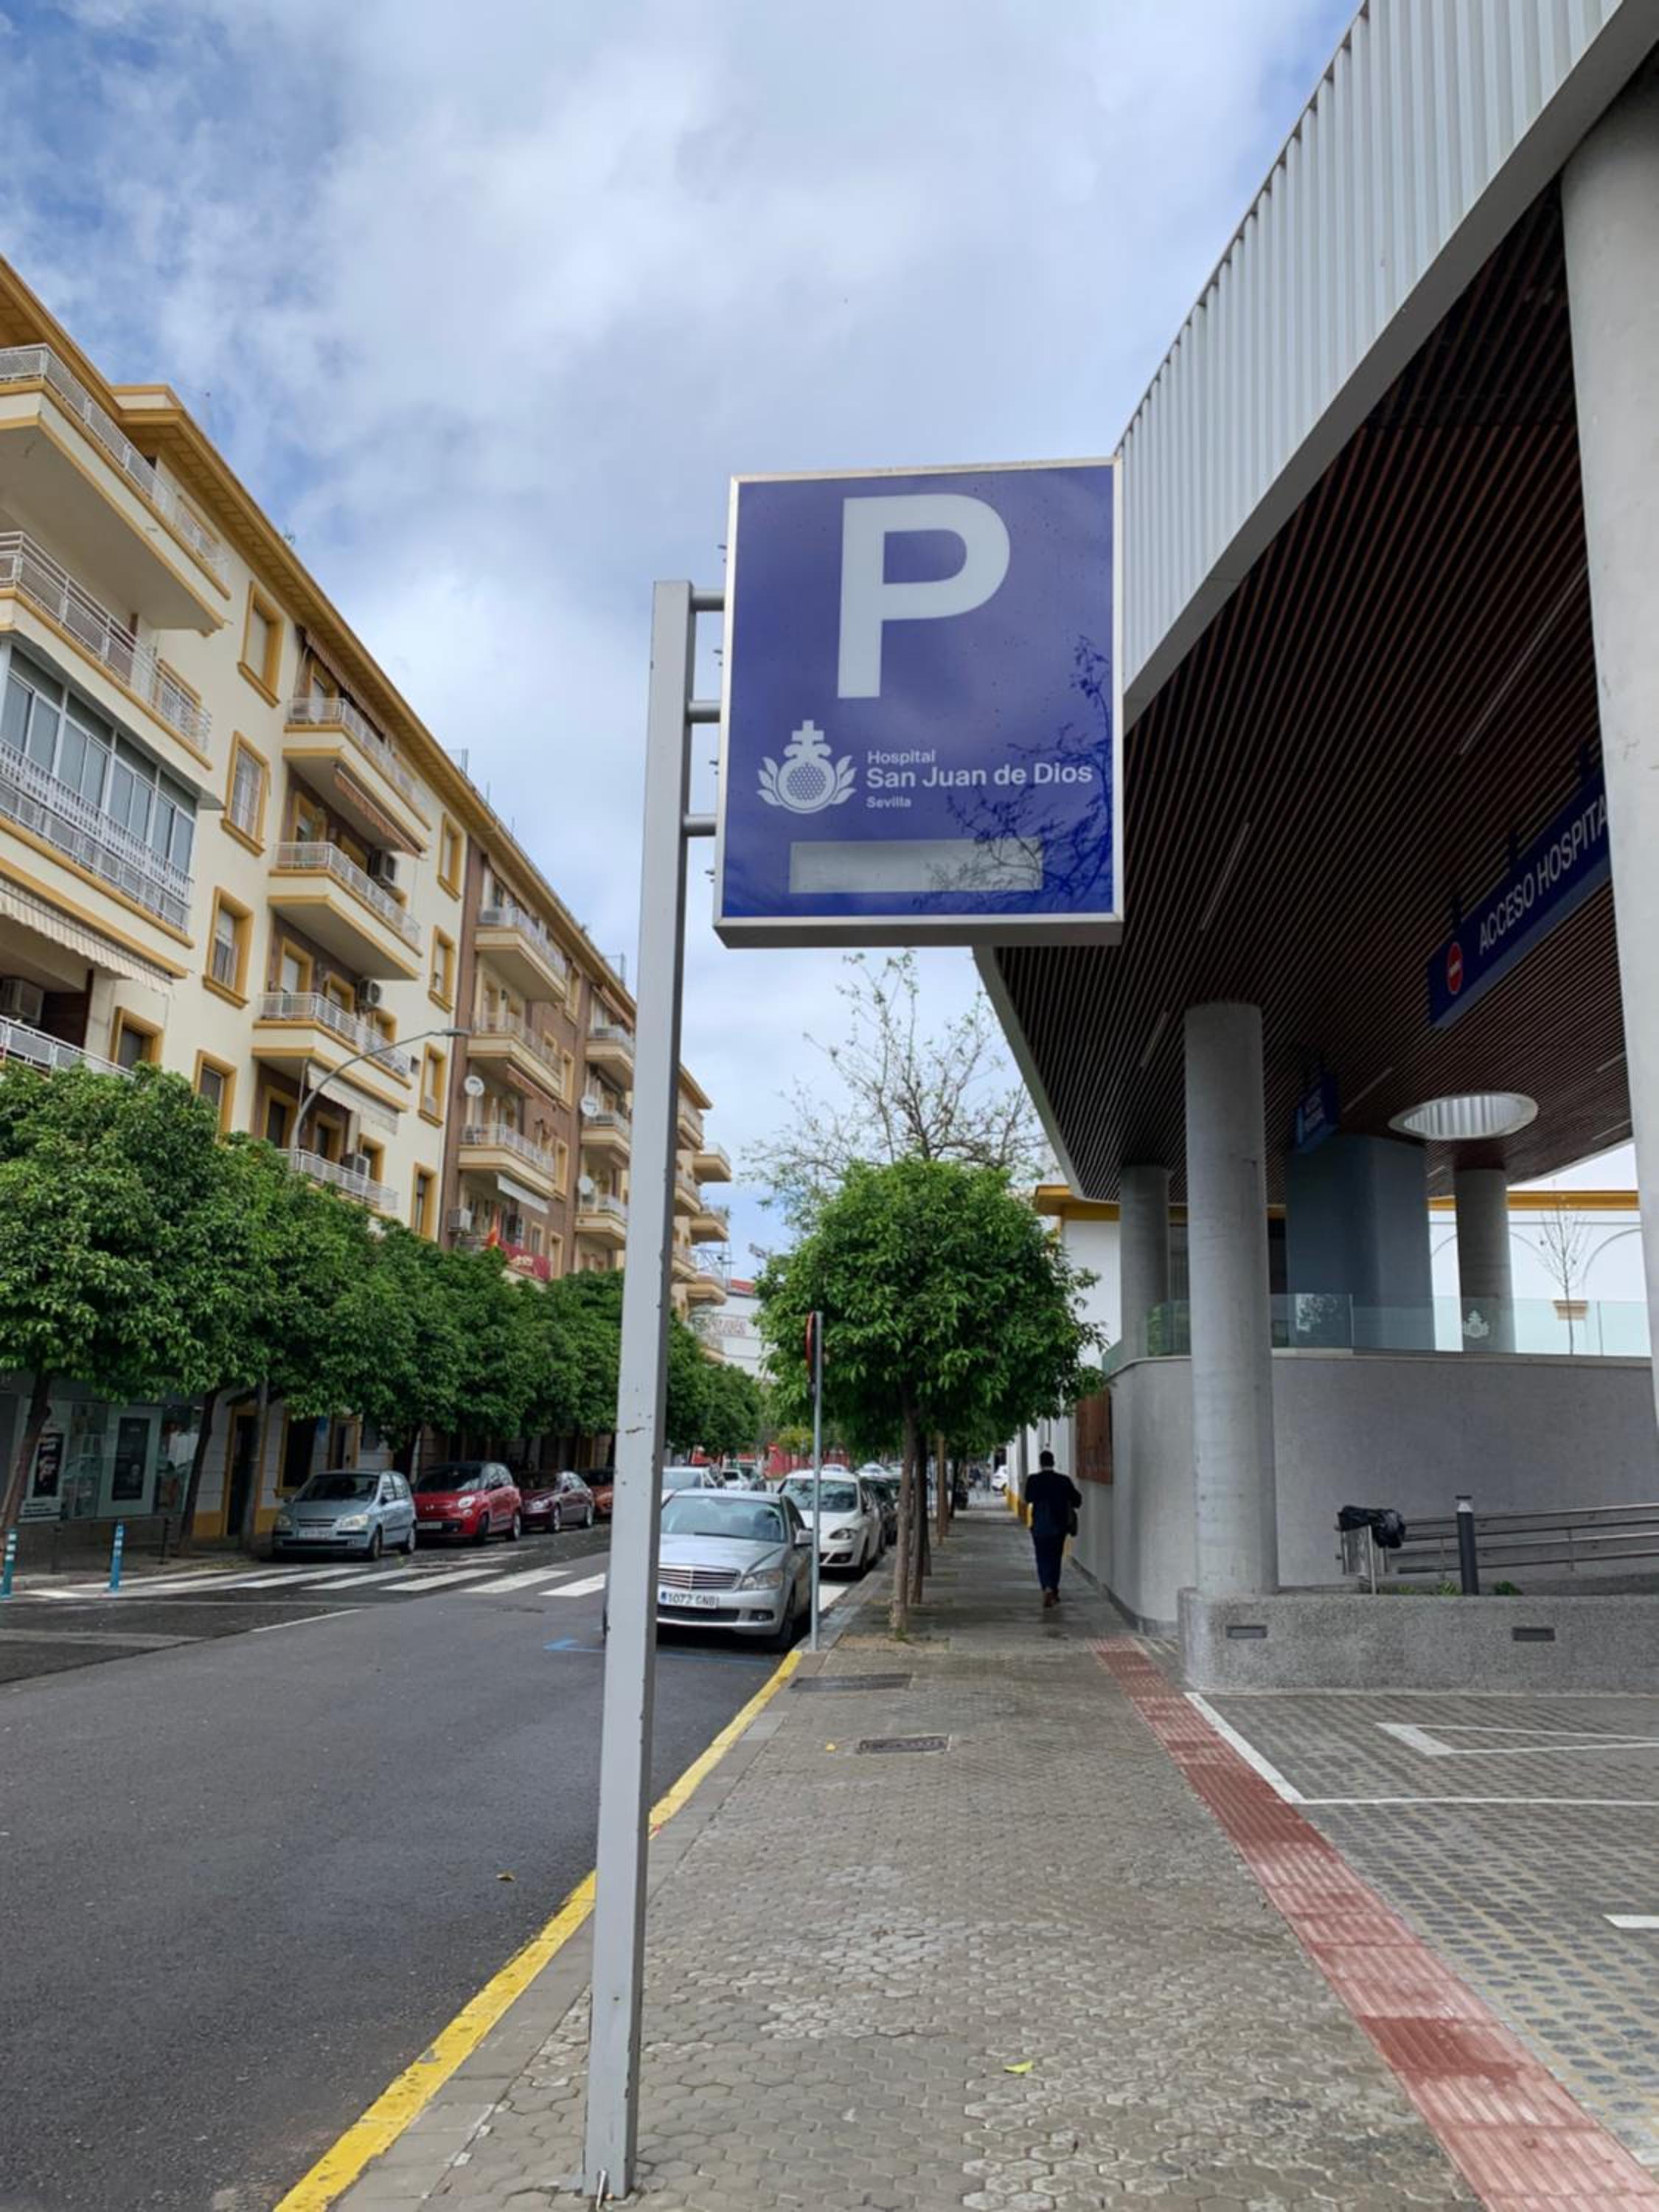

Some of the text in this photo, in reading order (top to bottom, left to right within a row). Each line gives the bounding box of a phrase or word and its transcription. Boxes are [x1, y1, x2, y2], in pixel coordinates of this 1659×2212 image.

[838, 493, 1010, 698] P
[867, 749, 936, 765] Hospital
[866, 762, 1093, 788] San Juan de Dios
[866, 796, 912, 808] Sevilla
[1479, 872, 1535, 956] ACCESO
